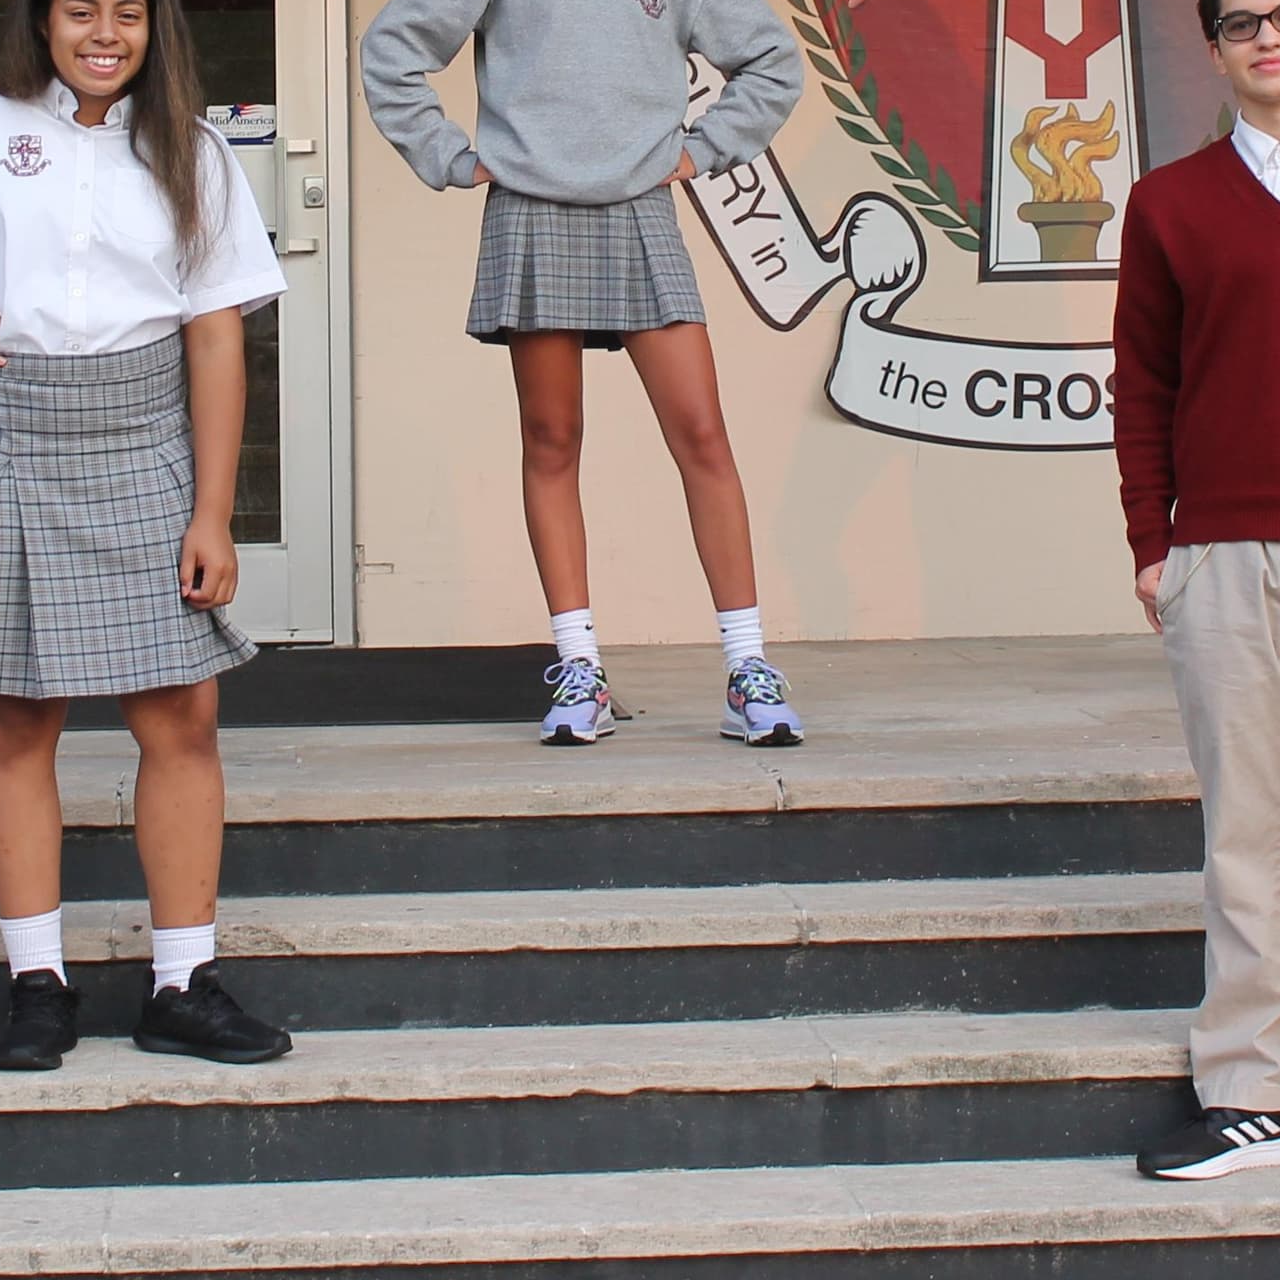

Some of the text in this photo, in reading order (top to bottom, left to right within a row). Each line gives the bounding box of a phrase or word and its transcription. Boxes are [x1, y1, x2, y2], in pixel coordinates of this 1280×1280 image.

[750, 235, 788, 282] in
[878, 359, 1115, 421] the CRO
